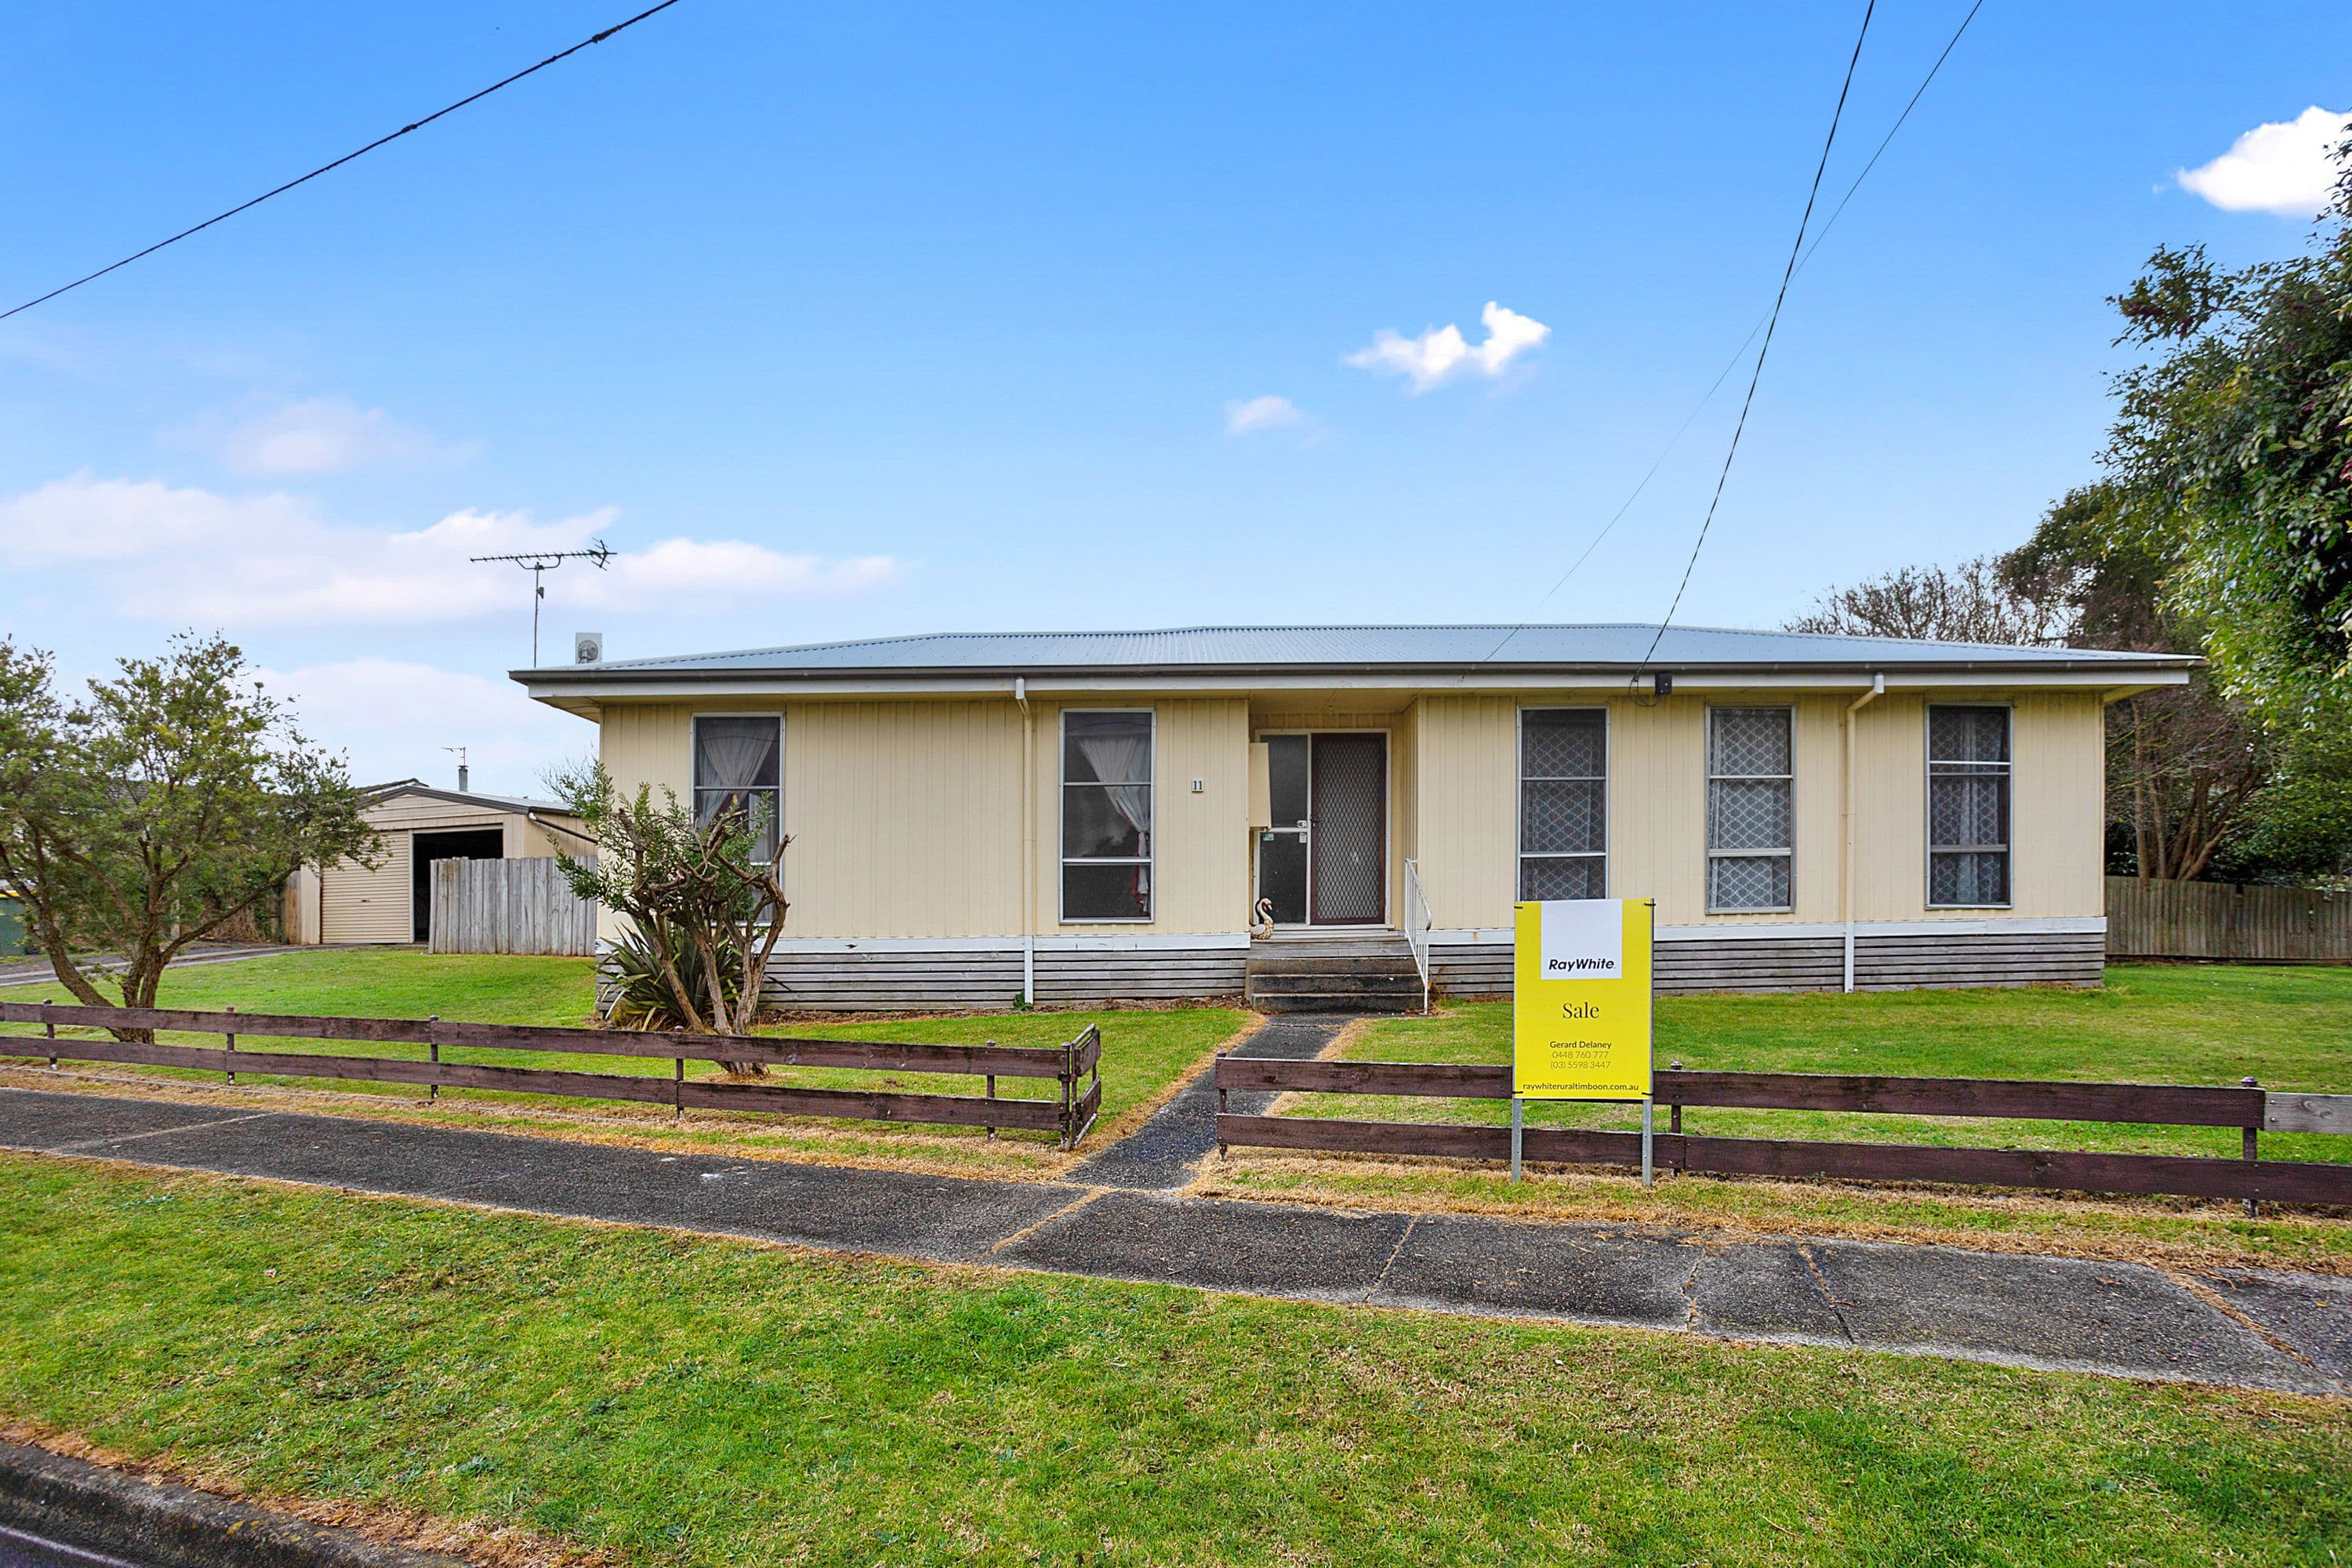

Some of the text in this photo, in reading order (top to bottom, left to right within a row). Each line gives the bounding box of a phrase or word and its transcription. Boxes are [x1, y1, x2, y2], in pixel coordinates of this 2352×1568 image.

[1193, 780, 1203, 790] 11
[1563, 1001, 1599, 1019] Sale
[1549, 1040, 1612, 1050] Gerard Delaney
[1552, 1051, 1610, 1059] 0448 760 777
[1550, 1061, 1611, 1069] (03) 5598 3447
[1523, 1082, 1639, 1091] raywhiteruraltimboon.com.au
